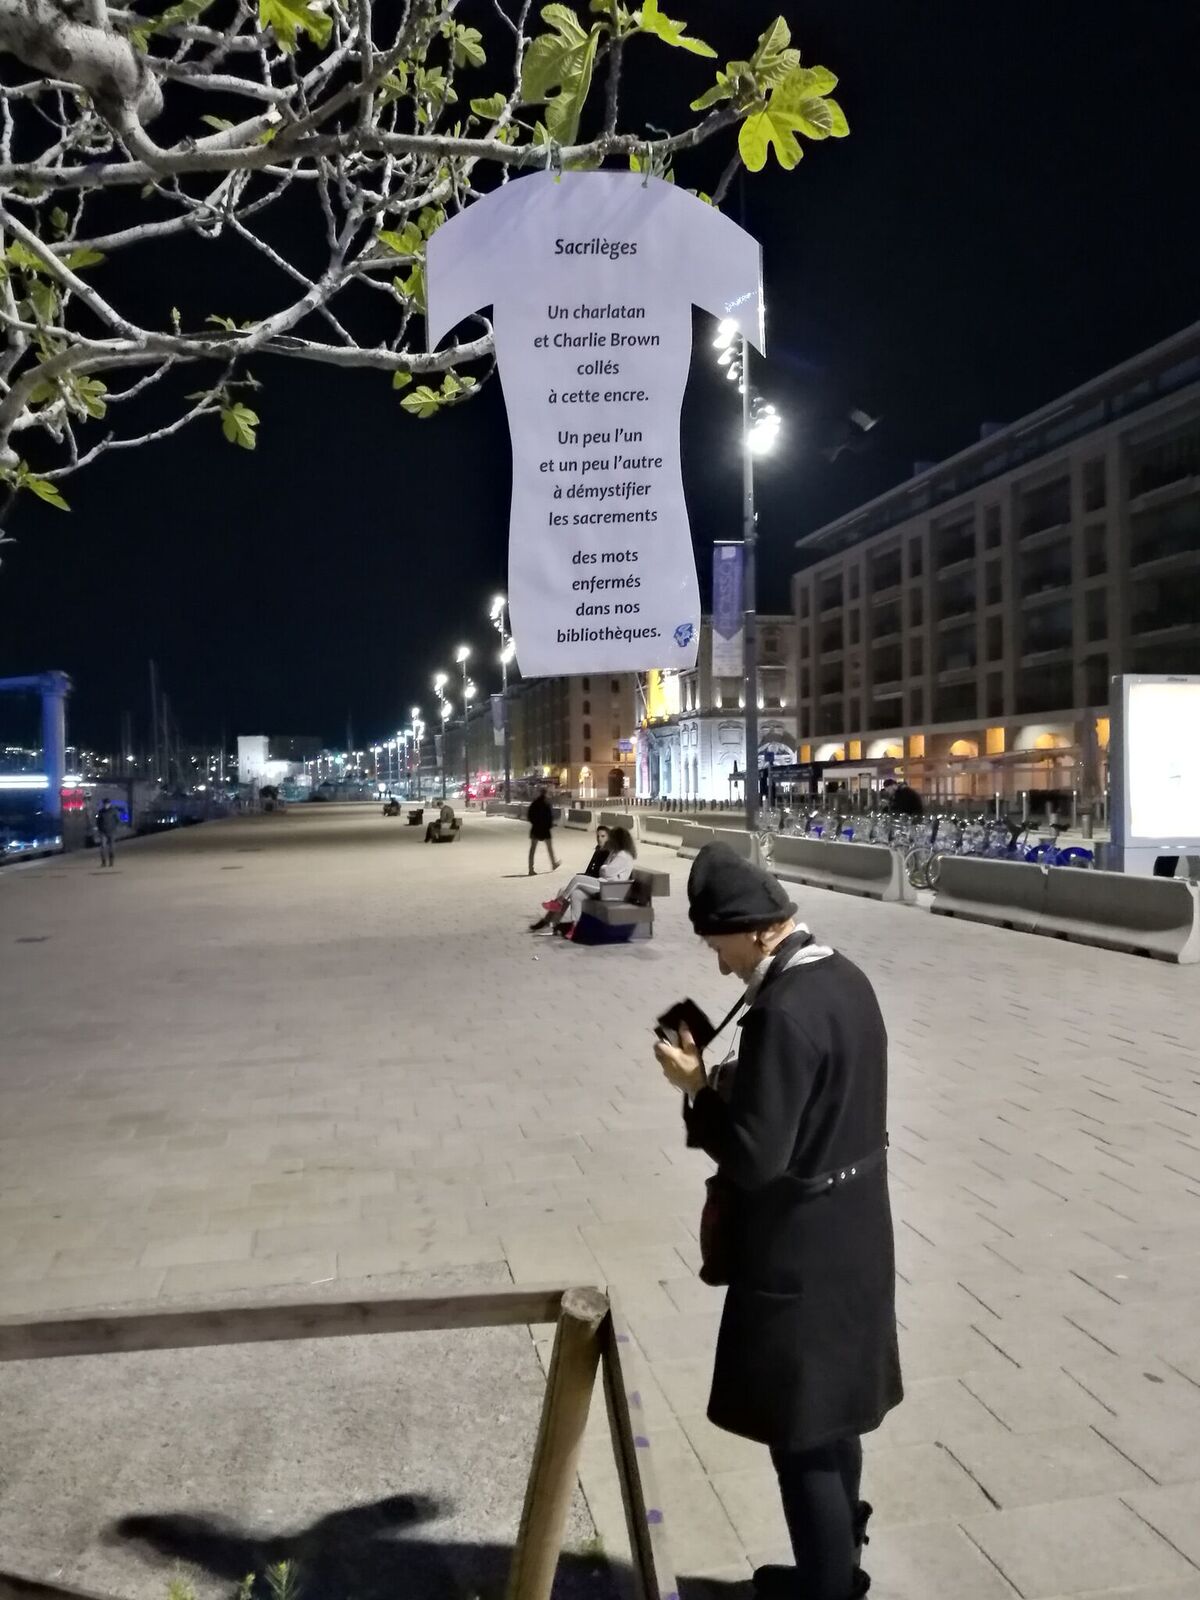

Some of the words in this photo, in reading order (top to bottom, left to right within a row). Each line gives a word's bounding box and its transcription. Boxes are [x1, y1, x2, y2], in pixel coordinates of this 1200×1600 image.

[553, 236, 638, 261] Sacrilèges
[547, 304, 569, 320] Un
[572, 303, 646, 320] charlatan
[533, 333, 550, 349] et
[552, 331, 607, 349] Charlie
[610, 332, 661, 348] Brown
[576, 359, 620, 376] collés
[547, 388, 558, 405] à
[561, 389, 601, 404] cette
[603, 390, 649, 403] encre.
[557, 430, 579, 447] Un
[582, 432, 611, 449] peu
[614, 427, 643, 444] l’un
[538, 459, 555, 473] et
[558, 458, 578, 473] un
[581, 459, 610, 476] peu
[613, 454, 663, 473] l’autre
[552, 484, 563, 500] à
[565, 479, 652, 502] démystifier
[548, 511, 570, 527] les
[572, 508, 658, 526] sacrements
[571, 549, 598, 566] des
[601, 549, 639, 564] mots
[571, 573, 641, 595] enfermés
[575, 601, 611, 617] dans
[614, 602, 641, 615] nos
[556, 625, 662, 644] bibliothèques.
